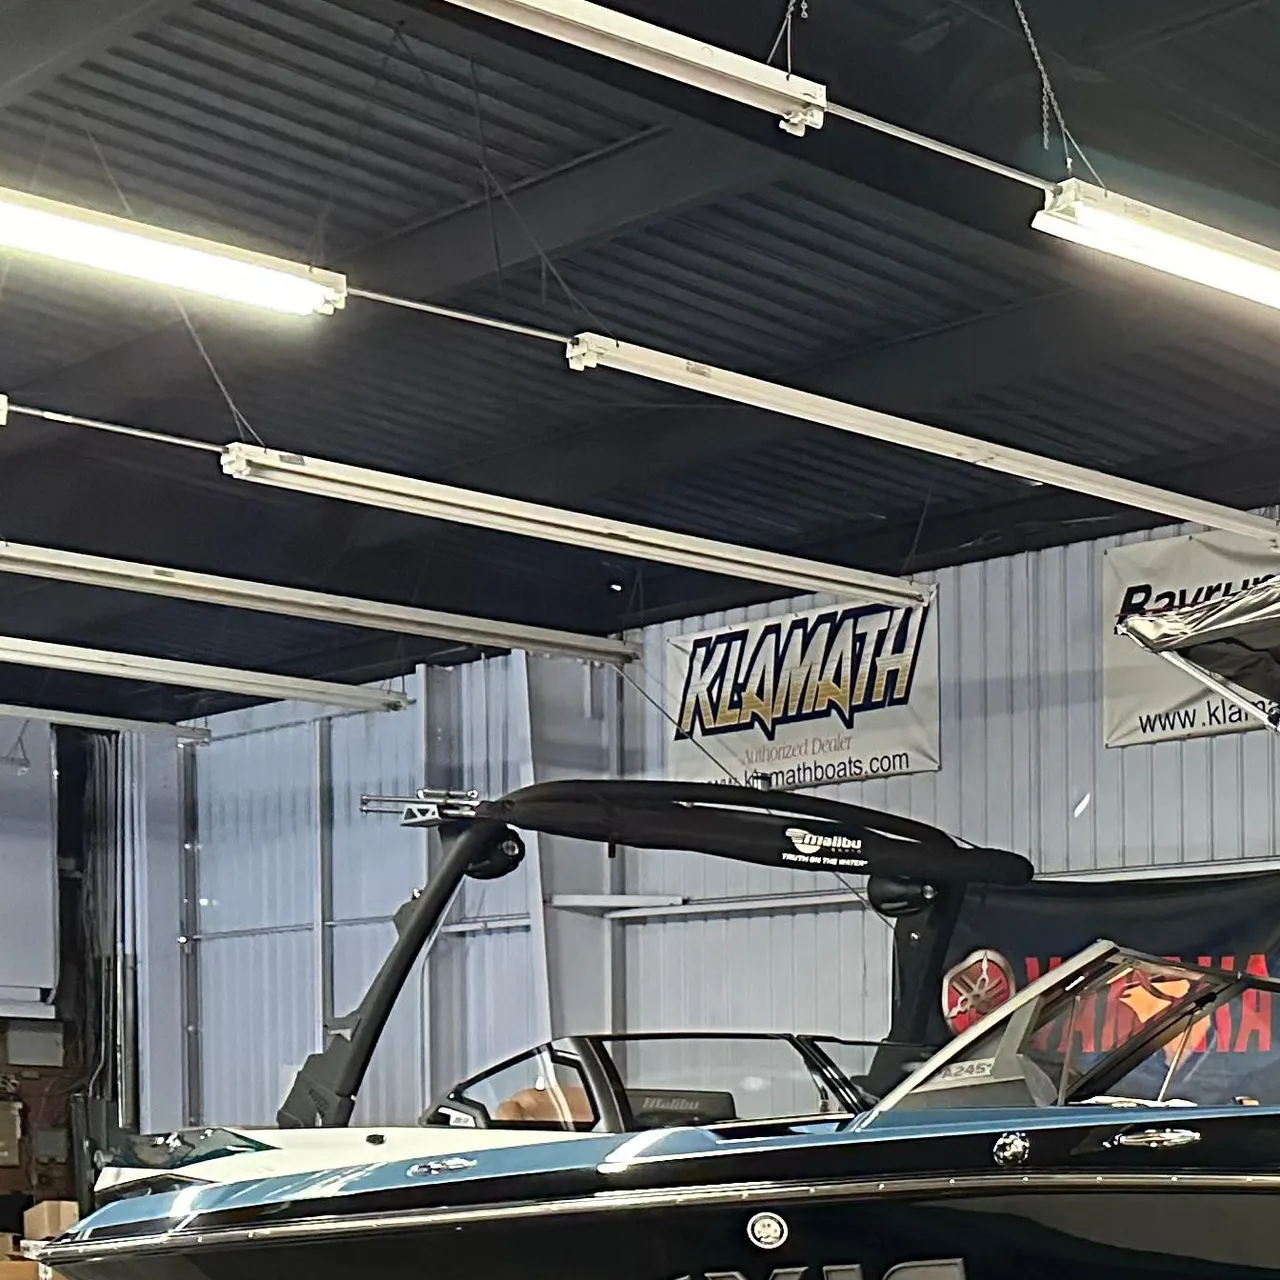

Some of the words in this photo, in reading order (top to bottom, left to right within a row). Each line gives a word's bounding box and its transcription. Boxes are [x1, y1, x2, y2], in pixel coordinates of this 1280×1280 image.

[675, 603, 928, 740] KLAMATH
[811, 735, 853, 756] Dealer
[822, 857, 838, 866] THE
